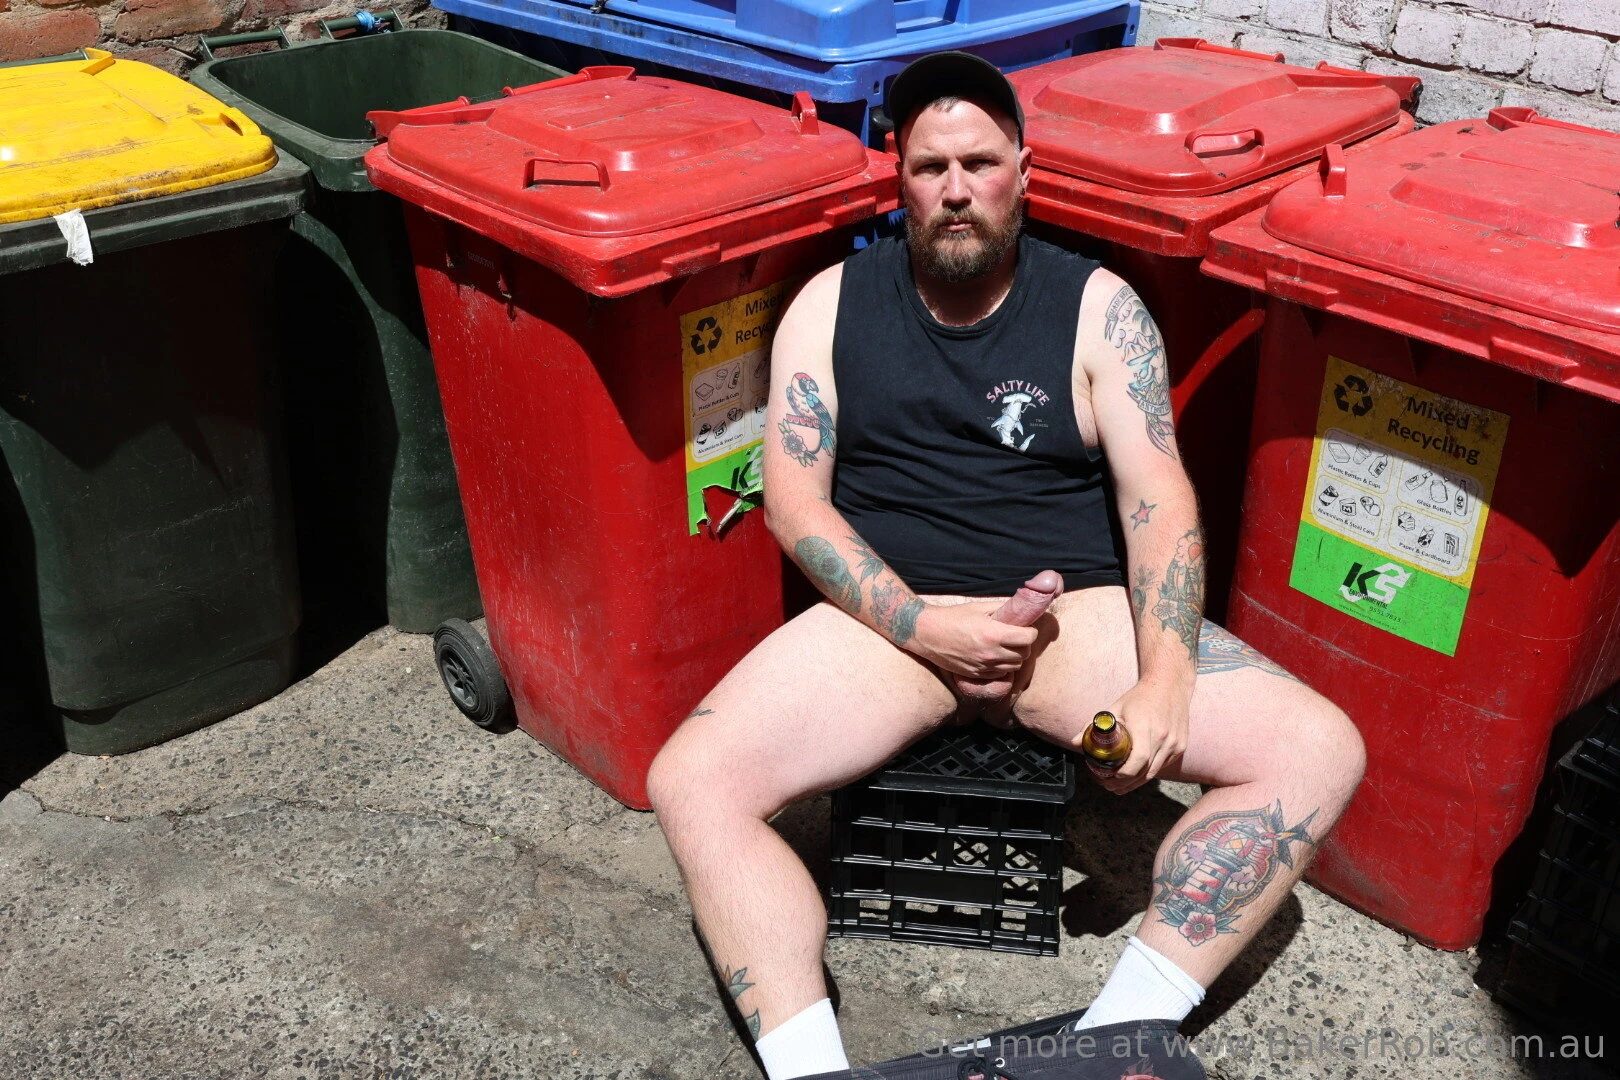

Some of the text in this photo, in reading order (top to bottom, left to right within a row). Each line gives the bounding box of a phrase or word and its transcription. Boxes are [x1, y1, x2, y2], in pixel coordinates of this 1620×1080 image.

[986, 380, 1050, 406] SALTY LIFE
[1407, 396, 1470, 429] Mixed
[1387, 418, 1481, 465] Recycling
[1327, 464, 1344, 474] Plastic
[1344, 471, 1362, 482] Bottles
[1369, 480, 1381, 489] Cups
[1416, 499, 1452, 515] Glass Bottles
[1350, 521, 1362, 531] Steel
[1363, 527, 1375, 536] Cans
[1399, 542, 1414, 552] Paper
[1421, 551, 1451, 565] Cardboard
[1340, 562, 1412, 604] K2
